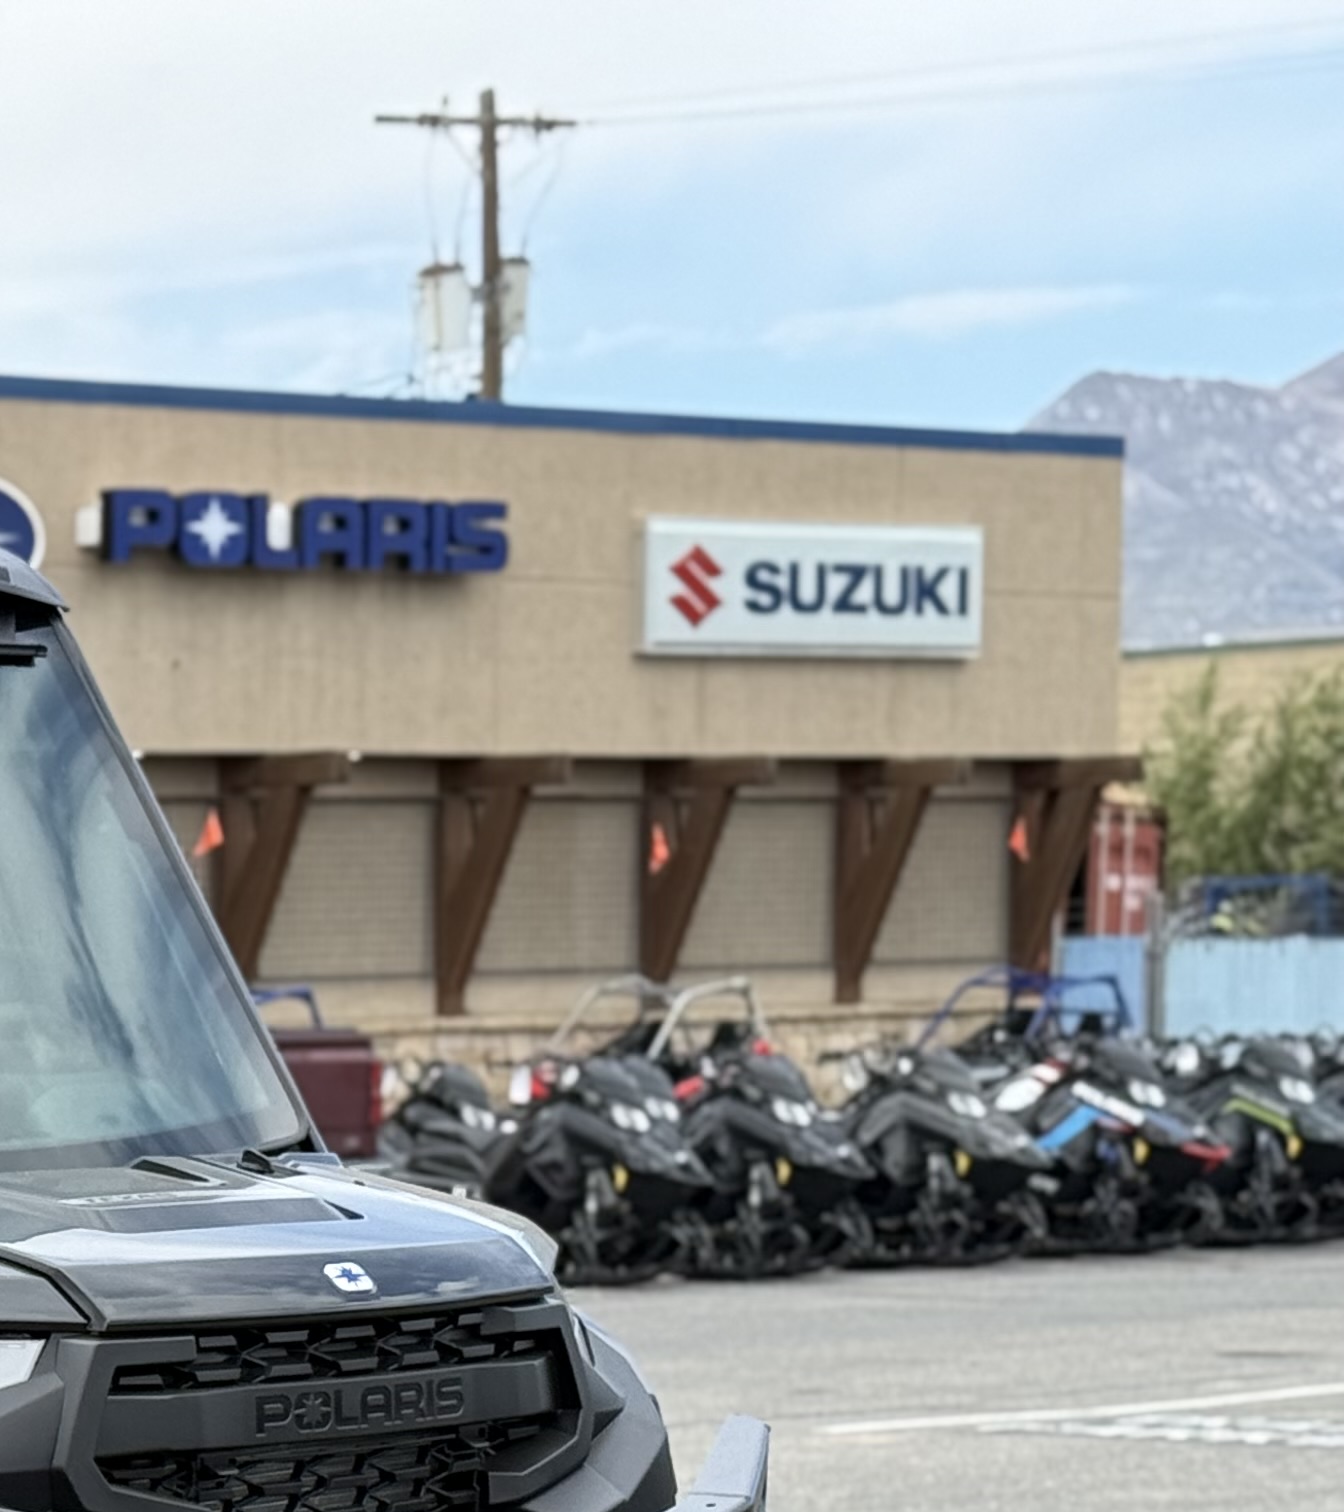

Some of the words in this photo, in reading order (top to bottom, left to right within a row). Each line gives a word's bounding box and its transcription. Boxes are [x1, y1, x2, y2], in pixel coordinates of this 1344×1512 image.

[101, 488, 509, 575] POLARIS
[744, 561, 970, 618] SUZUKI
[255, 1377, 465, 1438] POLARIS
